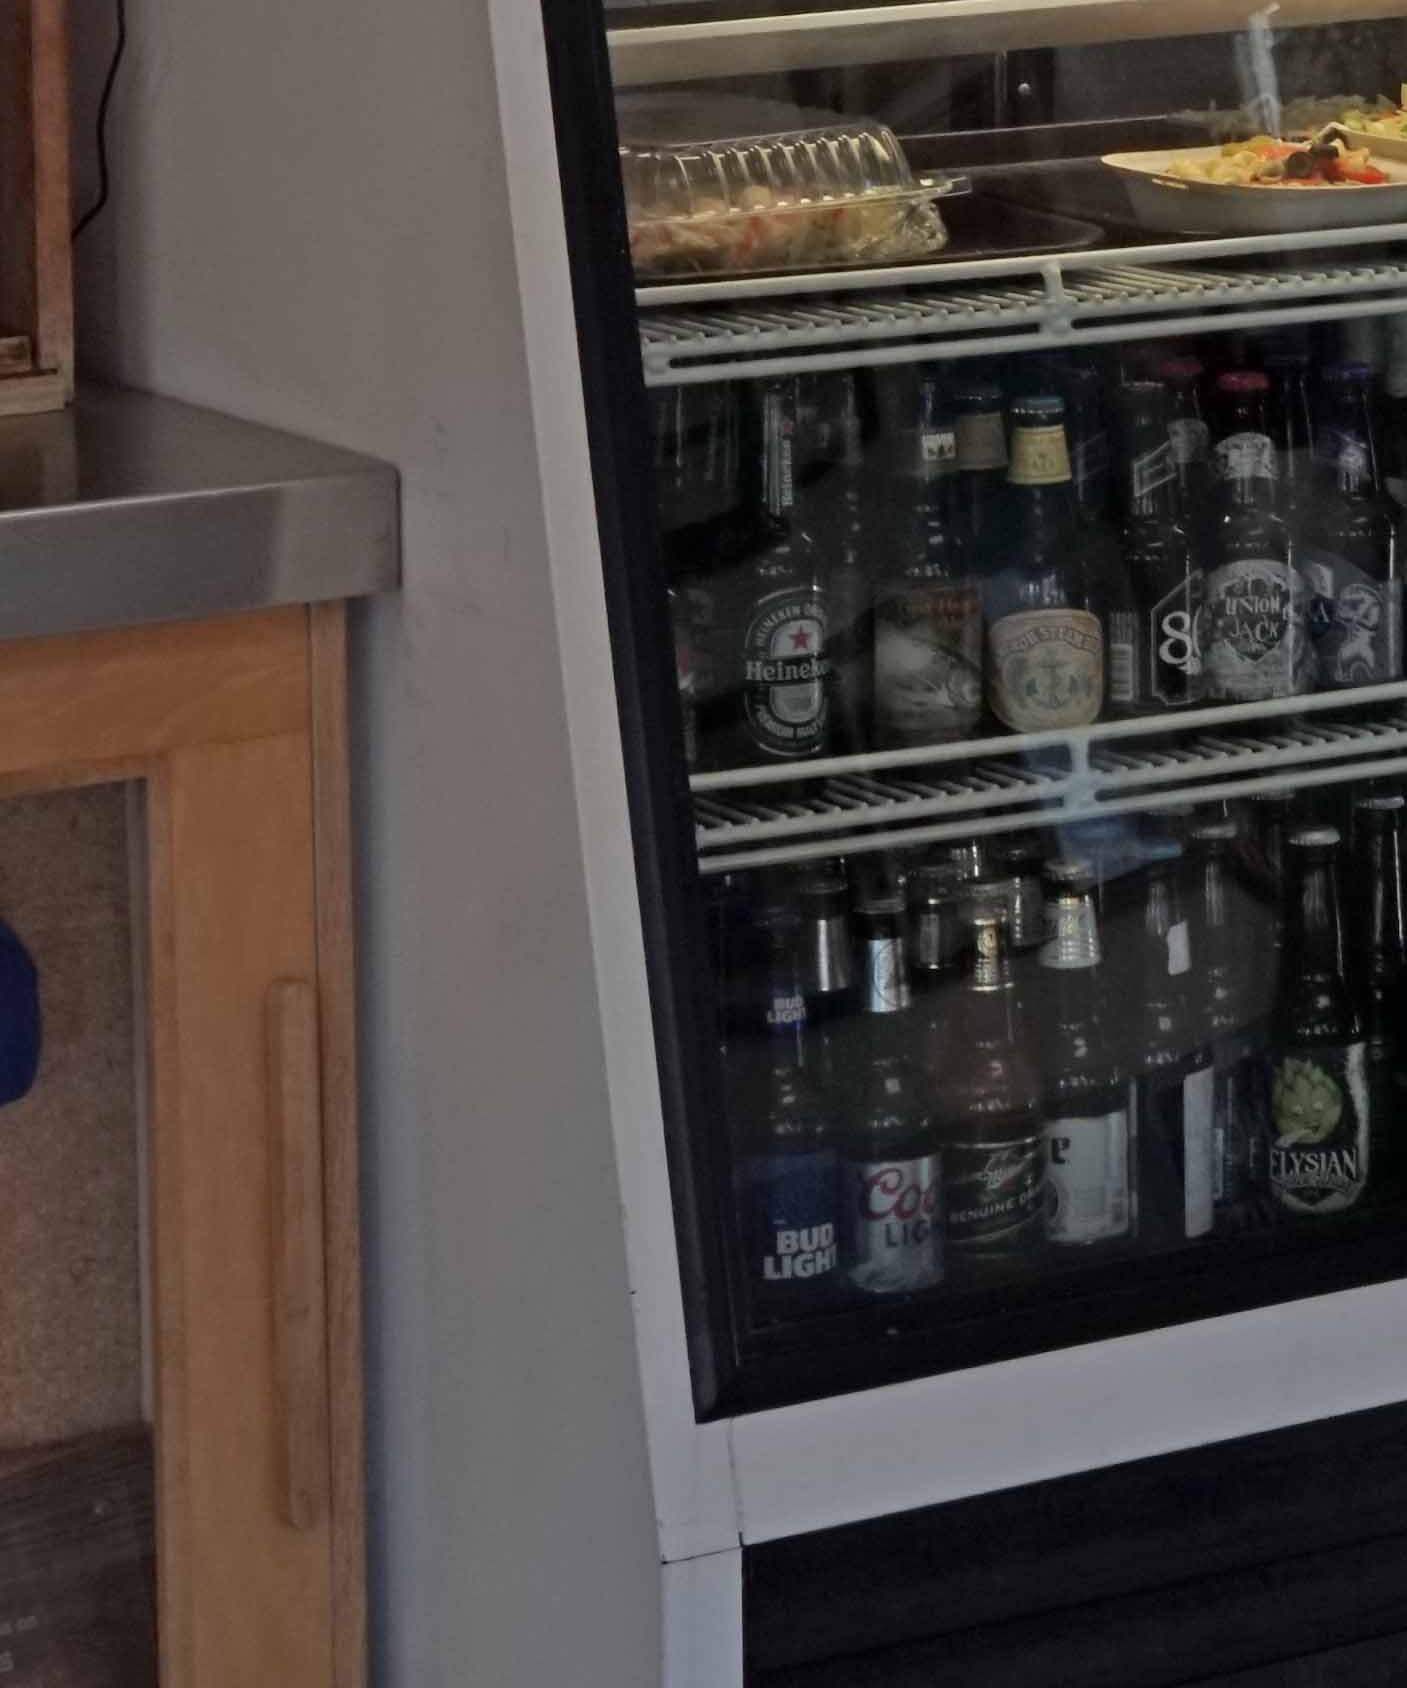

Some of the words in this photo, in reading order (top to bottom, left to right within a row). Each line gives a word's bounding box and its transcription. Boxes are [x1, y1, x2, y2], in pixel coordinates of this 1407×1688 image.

[1225, 595, 1280, 615] UNION
[1270, 1147, 1356, 1183] ELYSIAN
[777, 1223, 834, 1254] BUD
